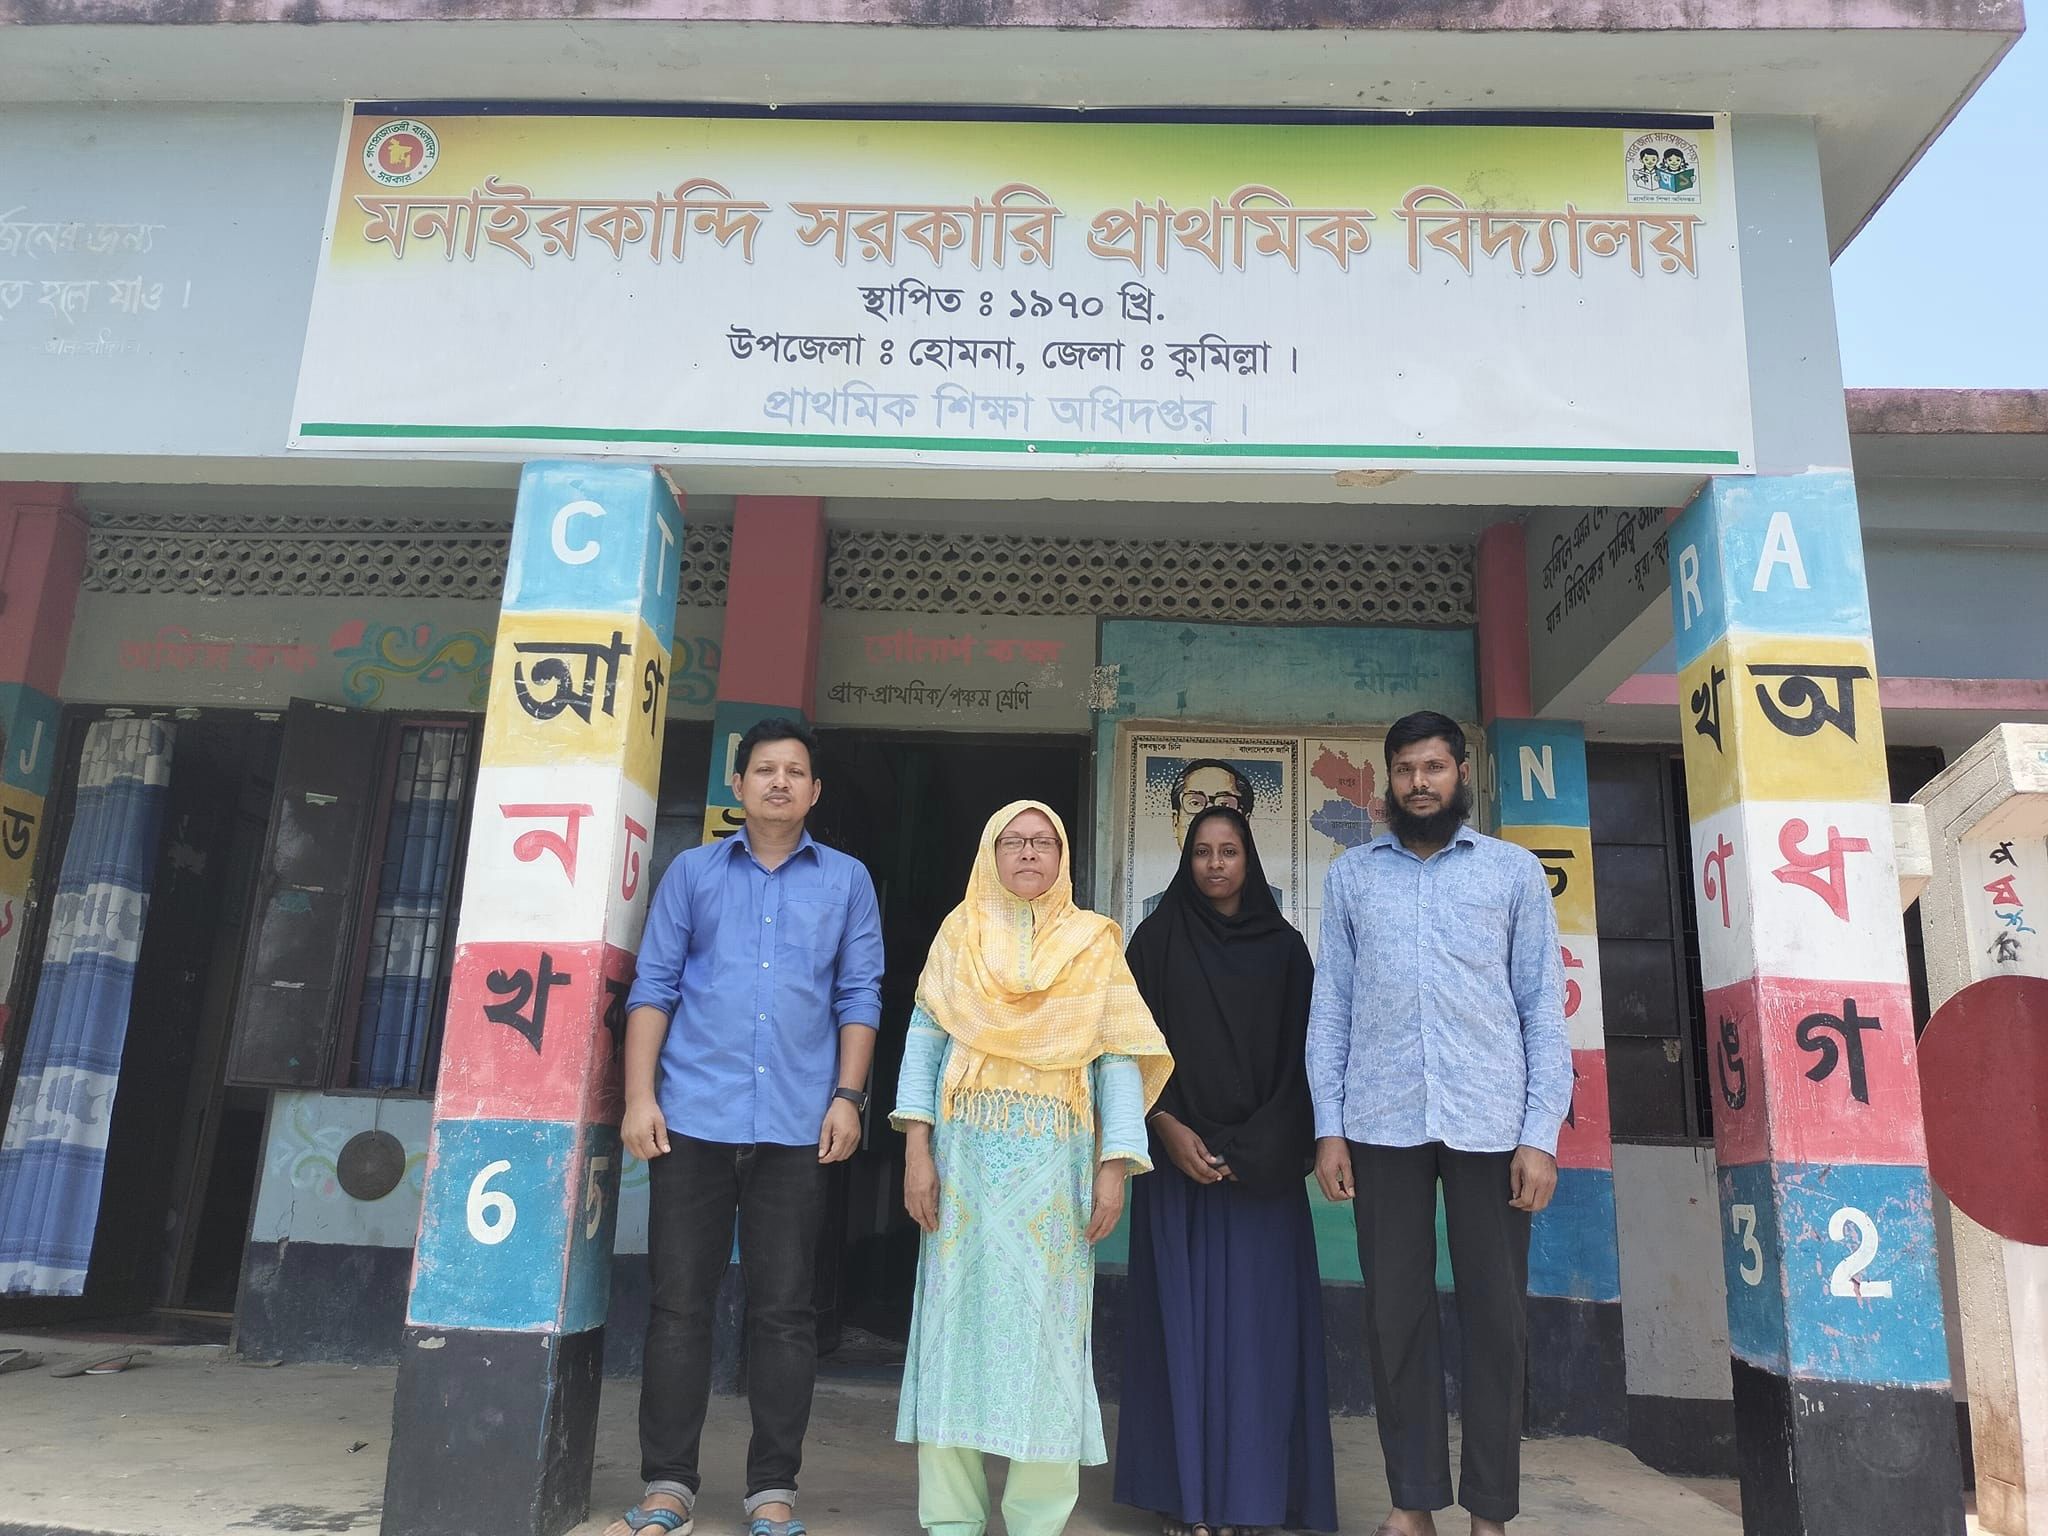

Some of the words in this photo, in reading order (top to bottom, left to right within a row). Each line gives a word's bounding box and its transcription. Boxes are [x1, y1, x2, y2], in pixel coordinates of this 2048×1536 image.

[378, 171, 412, 183] সরকার
[412, 125, 436, 160] বাংলাদেশ
[355, 176, 771, 269] মনাইরকান্দি
[788, 181, 1064, 271] সরকারি
[1085, 183, 1376, 275] প্রাথমিক
[1392, 185, 1704, 277] বিদ্যালয়
[857, 278, 965, 322] স্থাপিত
[1009, 290, 1104, 319] ১৯৭০
[1117, 282, 1165, 324] খ্রি.
[727, 323, 866, 367] উপজেলা
[909, 336, 1024, 375] হোমনা,
[1042, 339, 1126, 372] জেলা
[1166, 333, 1271, 381] কুমিল্লা
[763, 380, 919, 428] প্রাথমিক
[932, 382, 1035, 432] শিক্ষা
[1049, 385, 1217, 436] অধিদপ্তর
[551, 500, 606, 564] C
[656, 511, 676, 596] T
[1752, 511, 1811, 592] A
[1678, 543, 1704, 630] R
[514, 631, 632, 724] আ
[642, 653, 664, 739] গ
[996, 681, 1032, 712] শ্রেণি
[1691, 664, 1726, 754] খ
[1746, 664, 1873, 744] অ
[1519, 744, 1557, 801] N
[500, 803, 594, 887] ন
[1770, 817, 1873, 923] ধ
[483, 950, 572, 1056] খ
[1796, 997, 1882, 1105] গ
[466, 1159, 517, 1245] 6
[585, 1156, 609, 1239] 5
[1732, 1204, 1763, 1286] 3
[1828, 1206, 1893, 1298] 2
